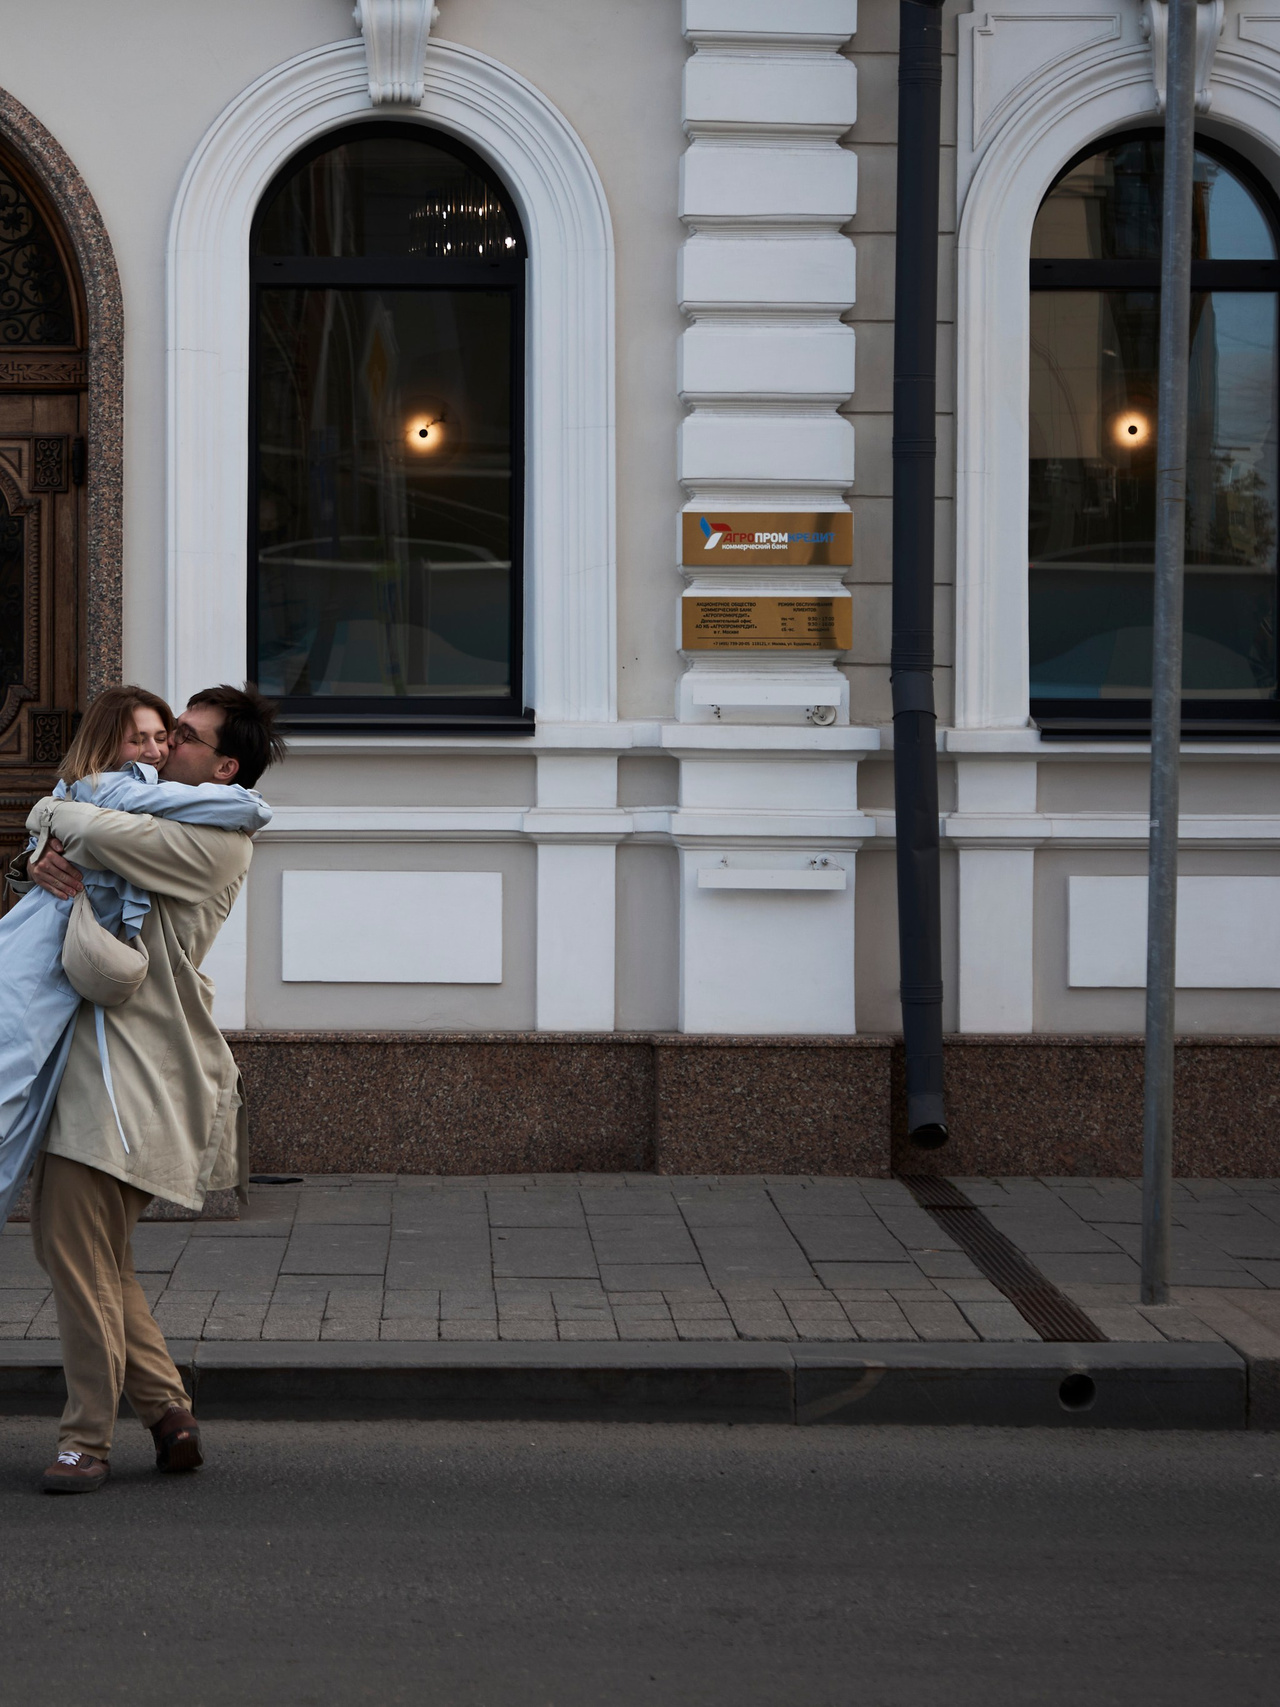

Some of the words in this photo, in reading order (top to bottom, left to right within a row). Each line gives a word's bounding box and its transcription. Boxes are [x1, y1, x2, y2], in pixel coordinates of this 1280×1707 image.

[722, 532, 836, 543] АГРОПРОМКРЕДИТ
[722, 543, 770, 551] коммерческий
[772, 543, 788, 551] банк
